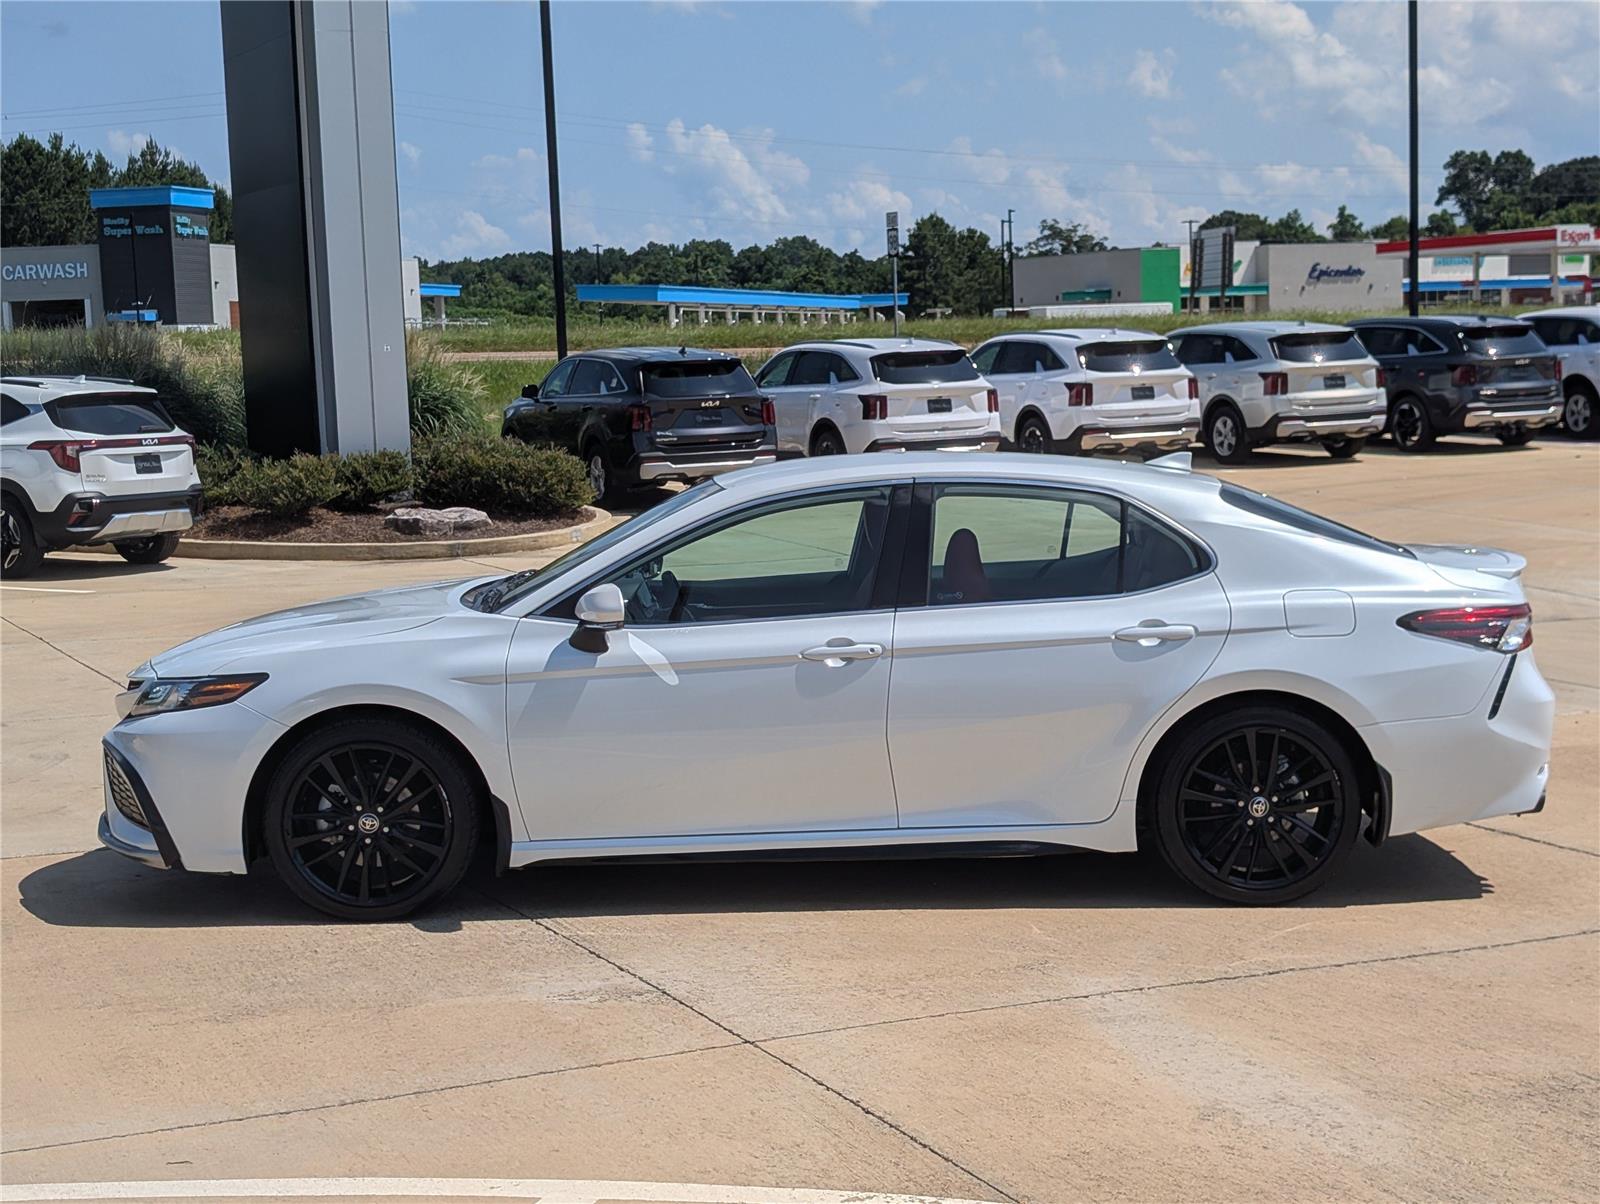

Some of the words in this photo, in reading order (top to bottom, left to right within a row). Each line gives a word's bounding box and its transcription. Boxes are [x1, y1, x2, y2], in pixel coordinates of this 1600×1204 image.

[103, 226, 132, 238] Super
[135, 225, 164, 235] Wash
[1561, 230, 1591, 246] Exxon
[2, 262, 88, 281] CARWASH
